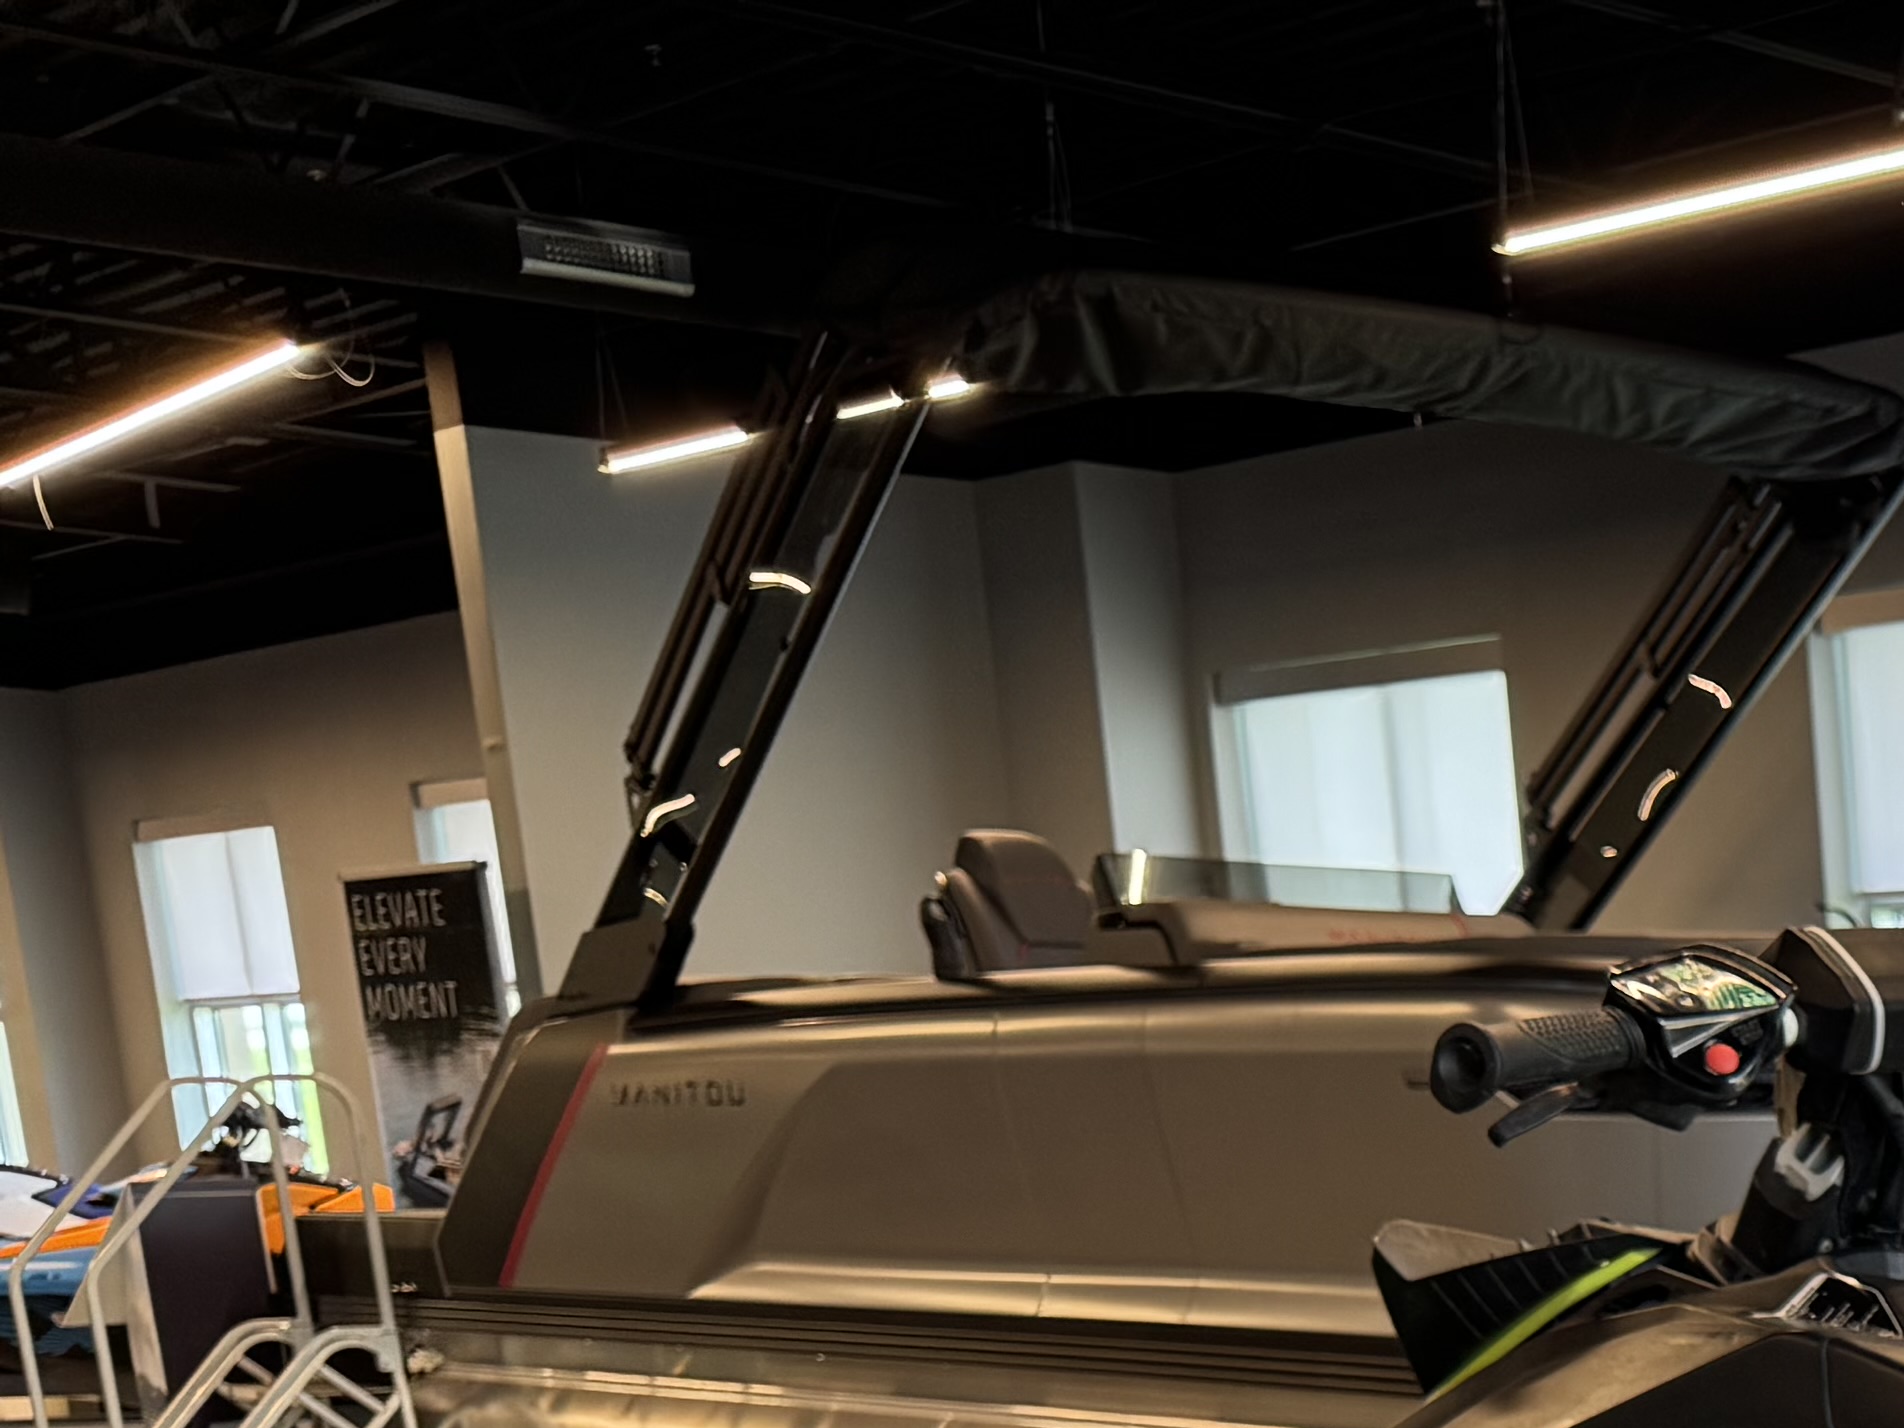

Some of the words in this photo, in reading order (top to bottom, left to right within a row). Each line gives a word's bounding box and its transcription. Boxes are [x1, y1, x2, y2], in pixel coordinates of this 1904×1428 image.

[351, 887, 447, 931] ELEVATE
[358, 935, 427, 976] EVERY
[364, 979, 459, 1021] MOMENT
